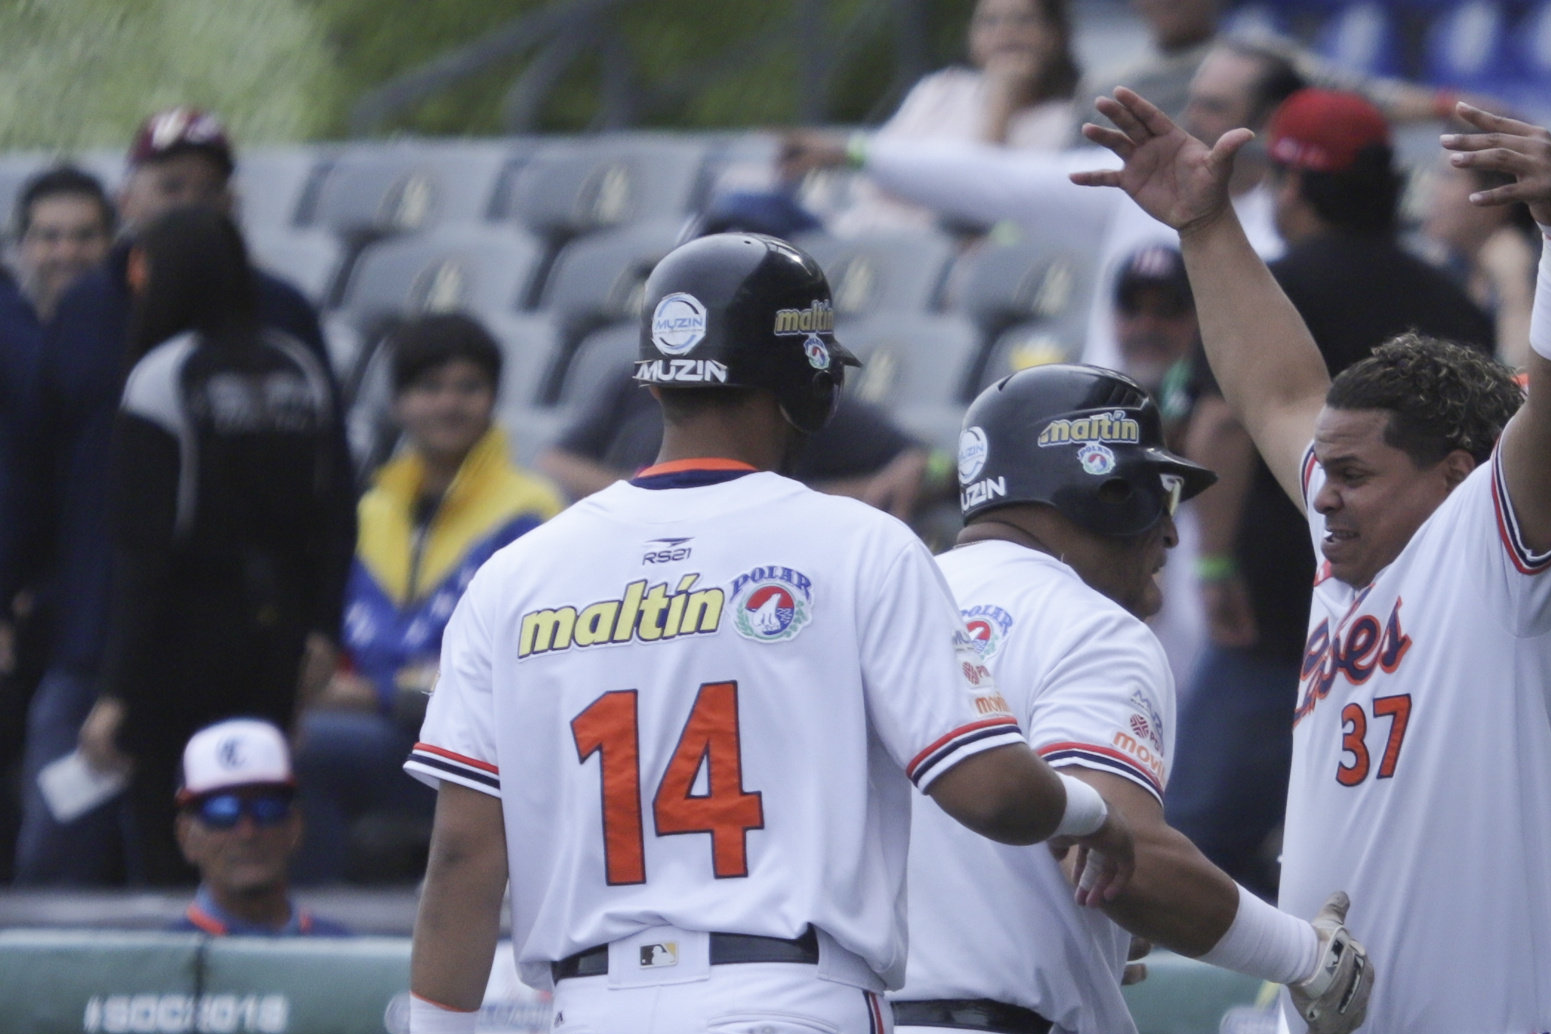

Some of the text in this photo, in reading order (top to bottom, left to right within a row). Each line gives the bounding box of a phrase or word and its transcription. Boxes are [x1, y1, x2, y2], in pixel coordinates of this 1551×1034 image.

[655, 318, 703, 330] MUZIN
[634, 359, 728, 383] MUZIN
[961, 476, 1006, 511] UZIN
[642, 547, 692, 566] RS21
[729, 565, 813, 602] POLAR
[518, 573, 725, 659] maltín
[1336, 693, 1413, 787] 37
[570, 680, 764, 886] 14
